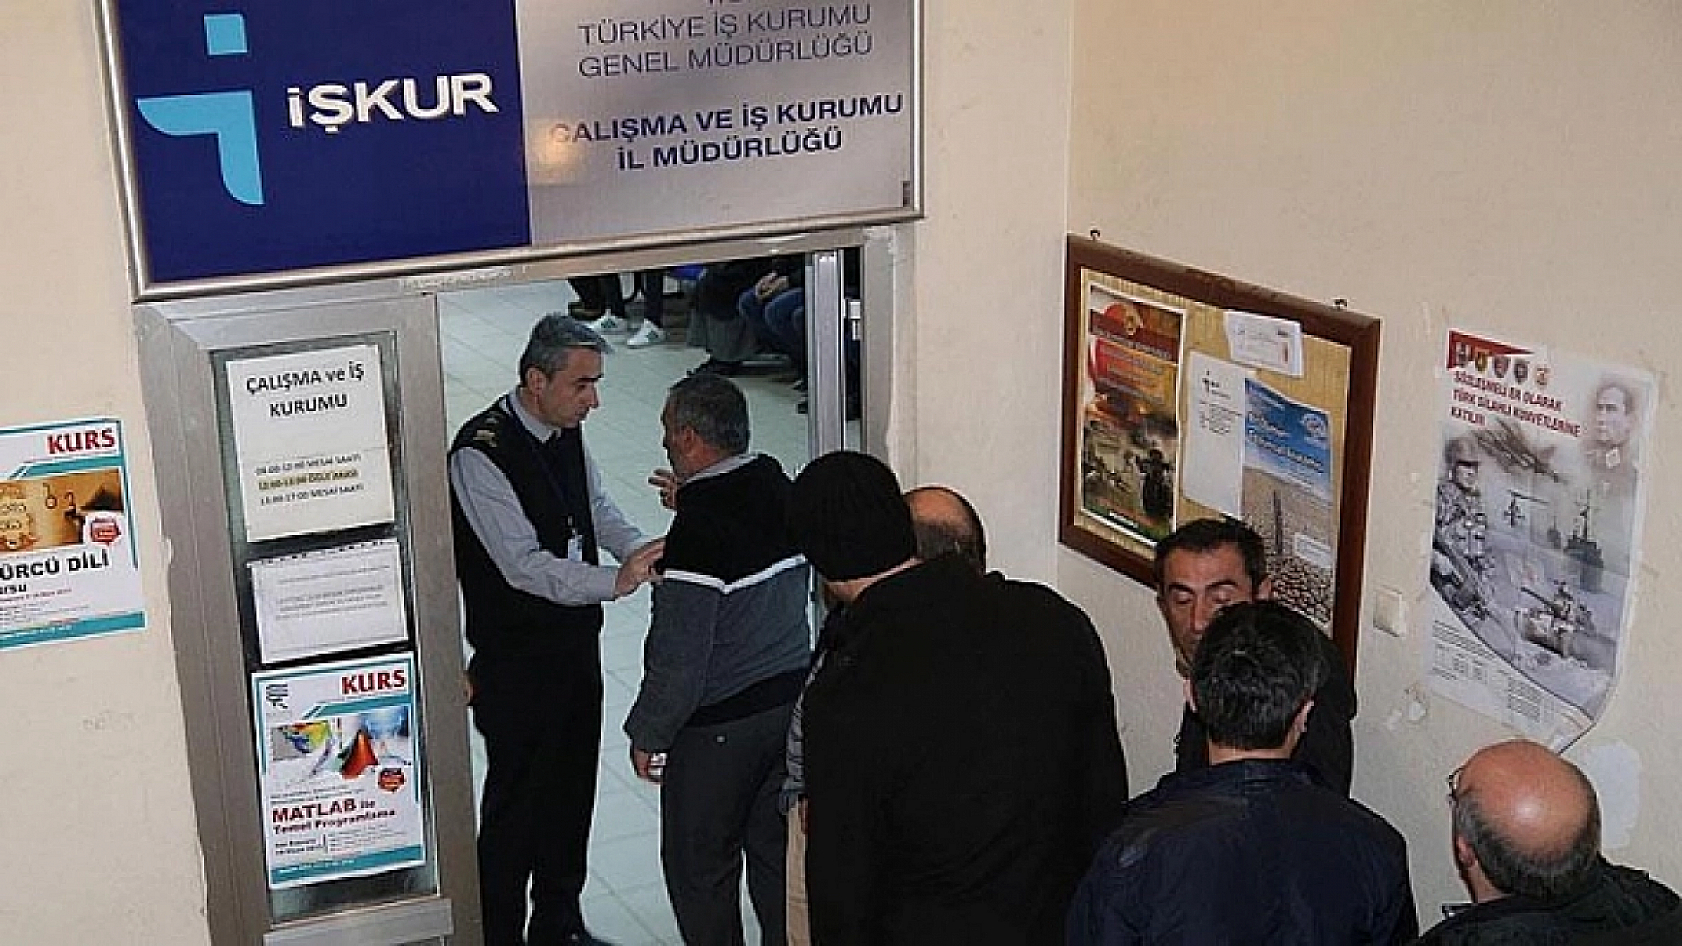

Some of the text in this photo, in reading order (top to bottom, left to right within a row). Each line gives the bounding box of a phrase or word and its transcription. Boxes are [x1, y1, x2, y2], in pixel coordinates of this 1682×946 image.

[578, 3, 872, 46] TÜRKİYE İŞ KURUMU
[578, 30, 873, 78] GENEL MÜDÜRLÜĞÜ
[696, 108, 733, 132] VE
[742, 102, 768, 128] İŞ
[777, 93, 904, 125] KURUMU
[617, 126, 843, 171] İL MÜDÜRLÜĞÜ
[246, 360, 365, 395] ÇALIŞMA ve İŞ
[269, 393, 347, 418] KURUMU
[47, 428, 116, 455] KURS
[67, 549, 110, 573] DİLİ
[342, 668, 405, 694] KURS
[272, 798, 357, 823] MATLAB
